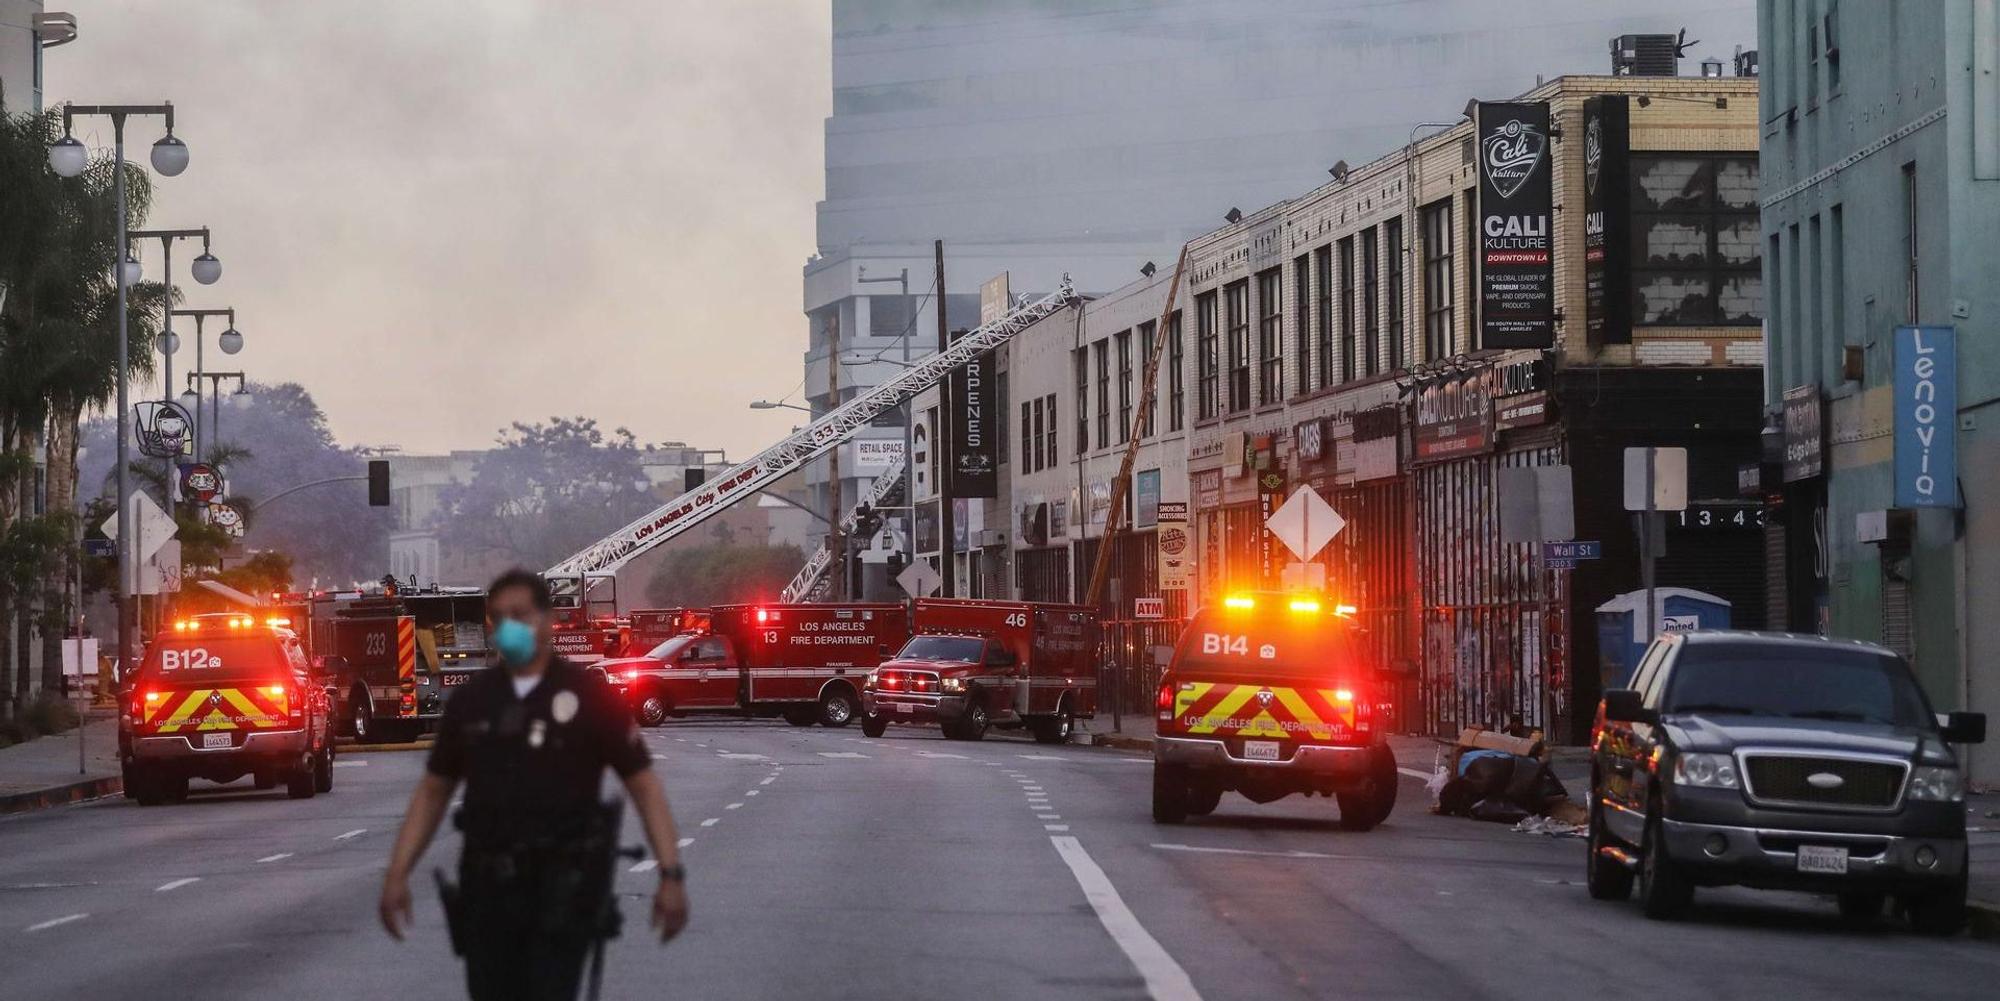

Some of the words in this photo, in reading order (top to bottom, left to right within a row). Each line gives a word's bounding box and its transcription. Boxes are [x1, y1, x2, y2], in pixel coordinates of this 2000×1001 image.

[1490, 133, 1528, 167] Cali
[1485, 215, 1546, 237] CALI
[1586, 212, 1603, 235] CALI
[1485, 238, 1546, 249] KULTURE
[1487, 254, 1536, 262] DOWNTOWN
[966, 358, 981, 447] RPENES
[1913, 328, 1936, 495] Lenovia
[814, 424, 834, 442] 33
[860, 443, 881, 453] RETAIL
[882, 443, 903, 453] SPACE
[635, 524, 654, 541] LOS
[654, 503, 694, 532] ANGELES
[694, 492, 716, 508] City
[717, 479, 738, 496] FIRE
[1159, 505, 1185, 513] SMOKING
[1553, 544, 1575, 556] Wall
[1579, 544, 1592, 556] St
[1138, 603, 1162, 615] ATM
[799, 622, 819, 632] LOS
[822, 622, 866, 632] ANGELES
[1005, 613, 1027, 628] 46
[366, 633, 386, 656] 233
[558, 635, 588, 643] ANGELES
[763, 631, 778, 644] 13
[790, 636, 812, 645] FIRE
[814, 635, 875, 645] DEPARTMENT
[1203, 633, 1249, 655] B14
[162, 648, 209, 670] B12
[235, 714, 280, 723] DEPARTMENT
[1184, 716, 1203, 727] LOS
[1209, 718, 1251, 729] ANGELES
[1256, 720, 1278, 731] FIRE
[1280, 721, 1345, 734] DEPARTMENT
